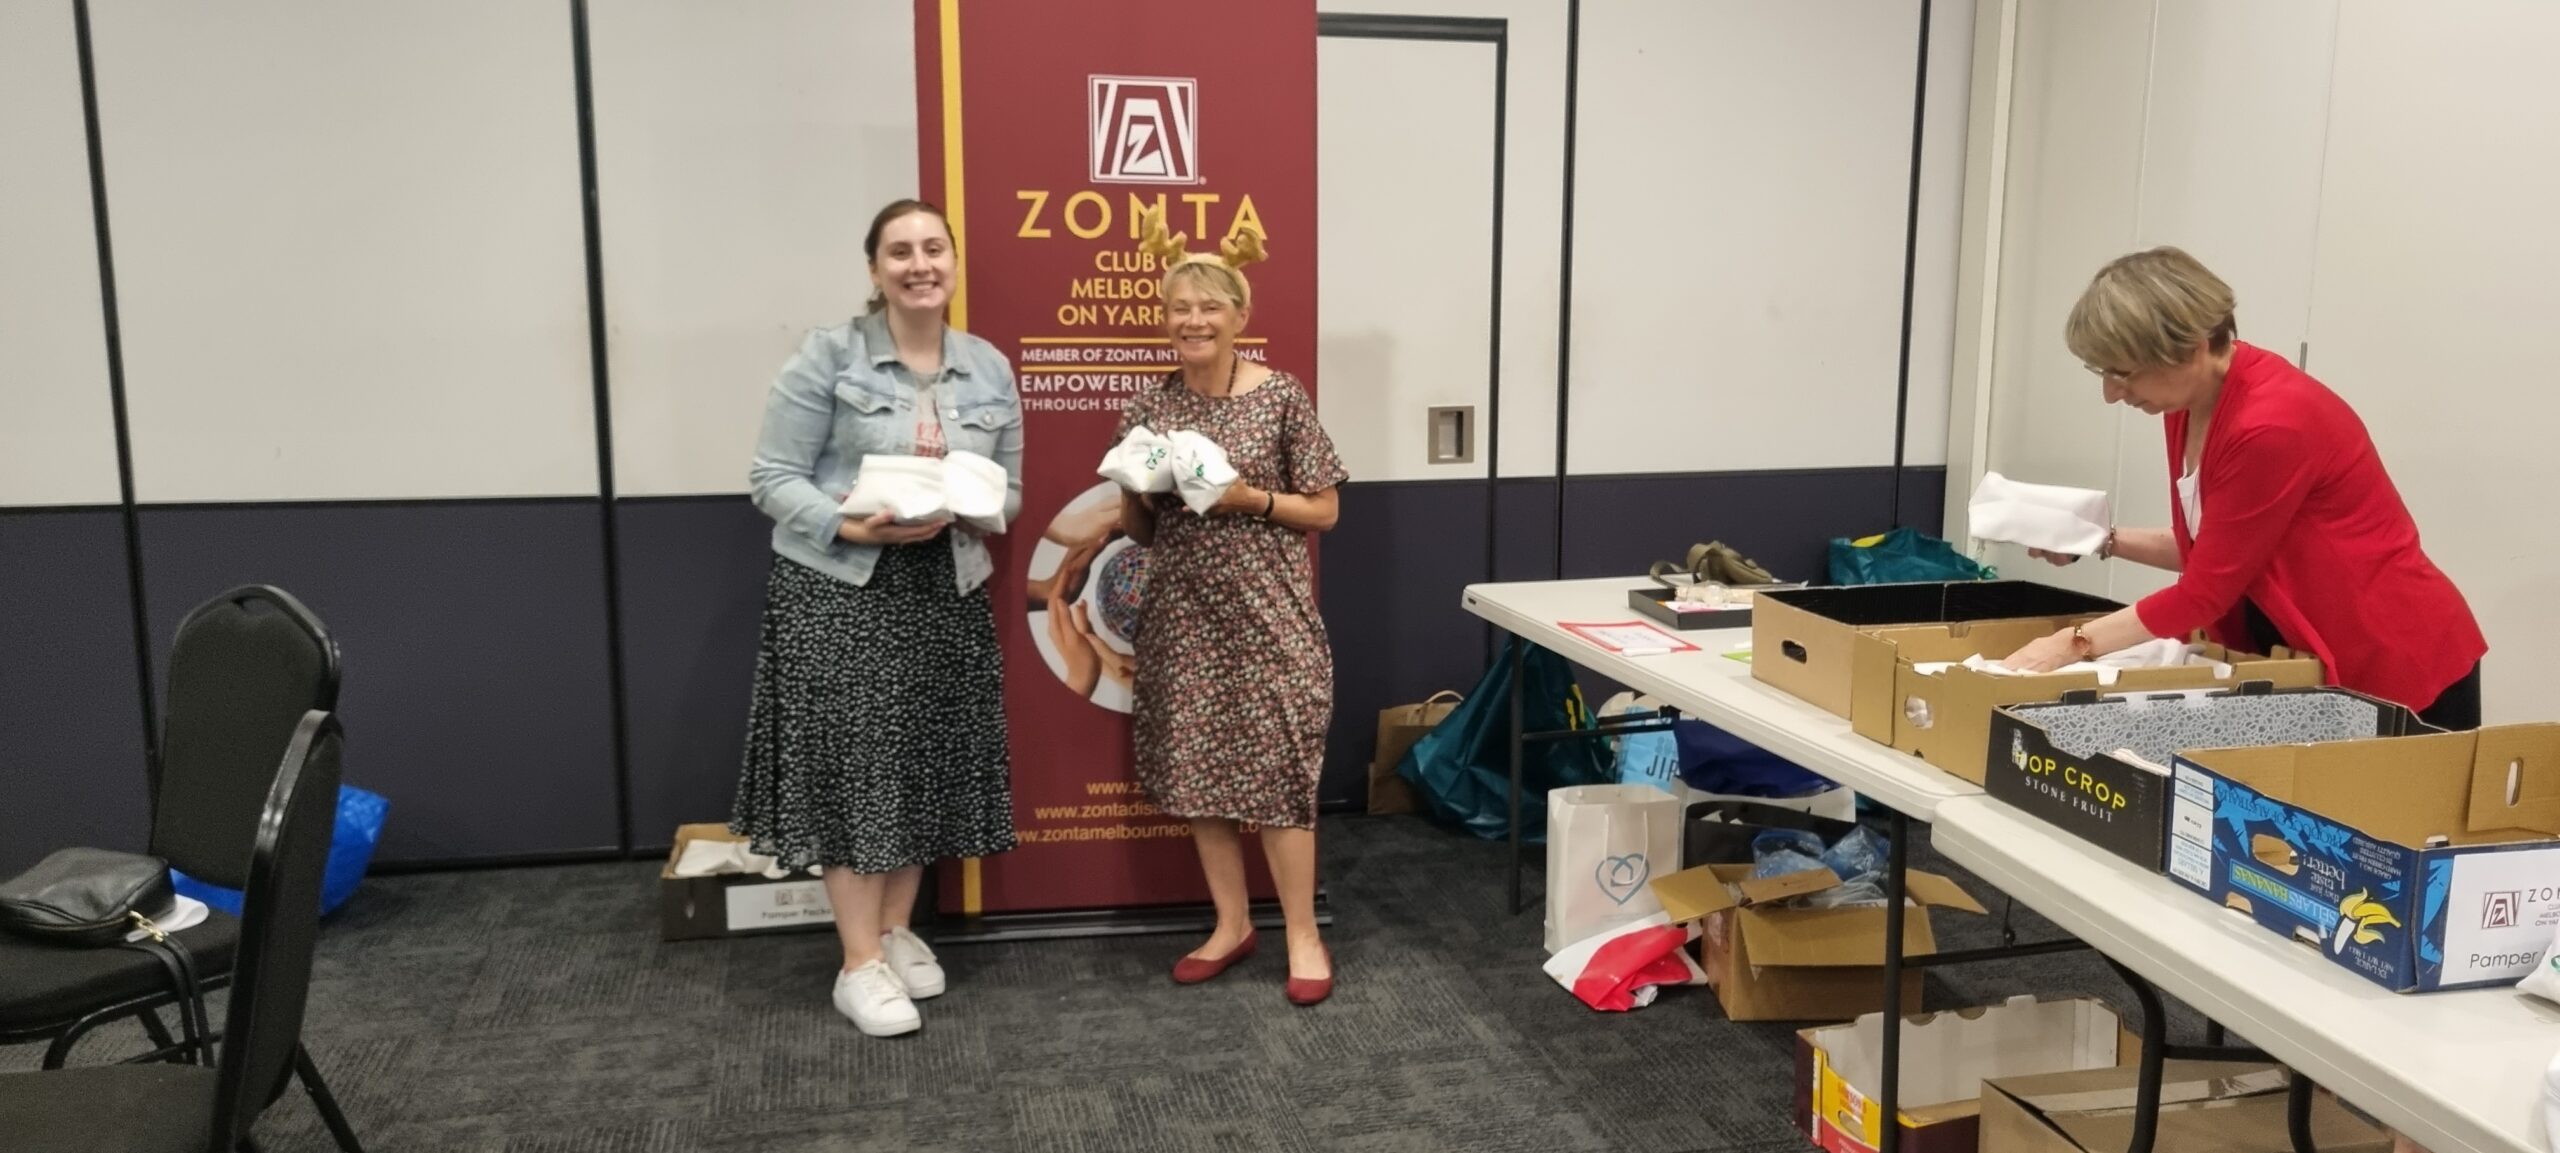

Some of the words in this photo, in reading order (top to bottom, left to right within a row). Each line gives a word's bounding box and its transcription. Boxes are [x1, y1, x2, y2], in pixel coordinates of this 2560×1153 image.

[1016, 190, 1268, 240] ZONTA
[1095, 250, 1157, 273] CLUB
[1071, 278, 1162, 299] MELBO
[1057, 304, 1098, 326] ON
[1102, 304, 1165, 326] YARR
[1021, 348, 1080, 362] MEMBER
[1082, 348, 1103, 362] OF
[1105, 348, 1154, 362] ZONTA
[1021, 374, 1158, 393] EMPOWERIN
[1022, 398, 1100, 411] THROUGH
[1086, 780, 1143, 795] www.z
[2064, 766, 2126, 809] CROP
[2025, 776, 2066, 802] STONE
[2073, 796, 2113, 823] FRUIT
[1034, 801, 1157, 819] www.zontadis
[2234, 865, 2289, 902] BANANAS
[2310, 871, 2334, 891] taste
[2528, 886, 2560, 903] ZO
[2288, 891, 2337, 927] SELLARS
[2469, 951, 2539, 969] Pamper
